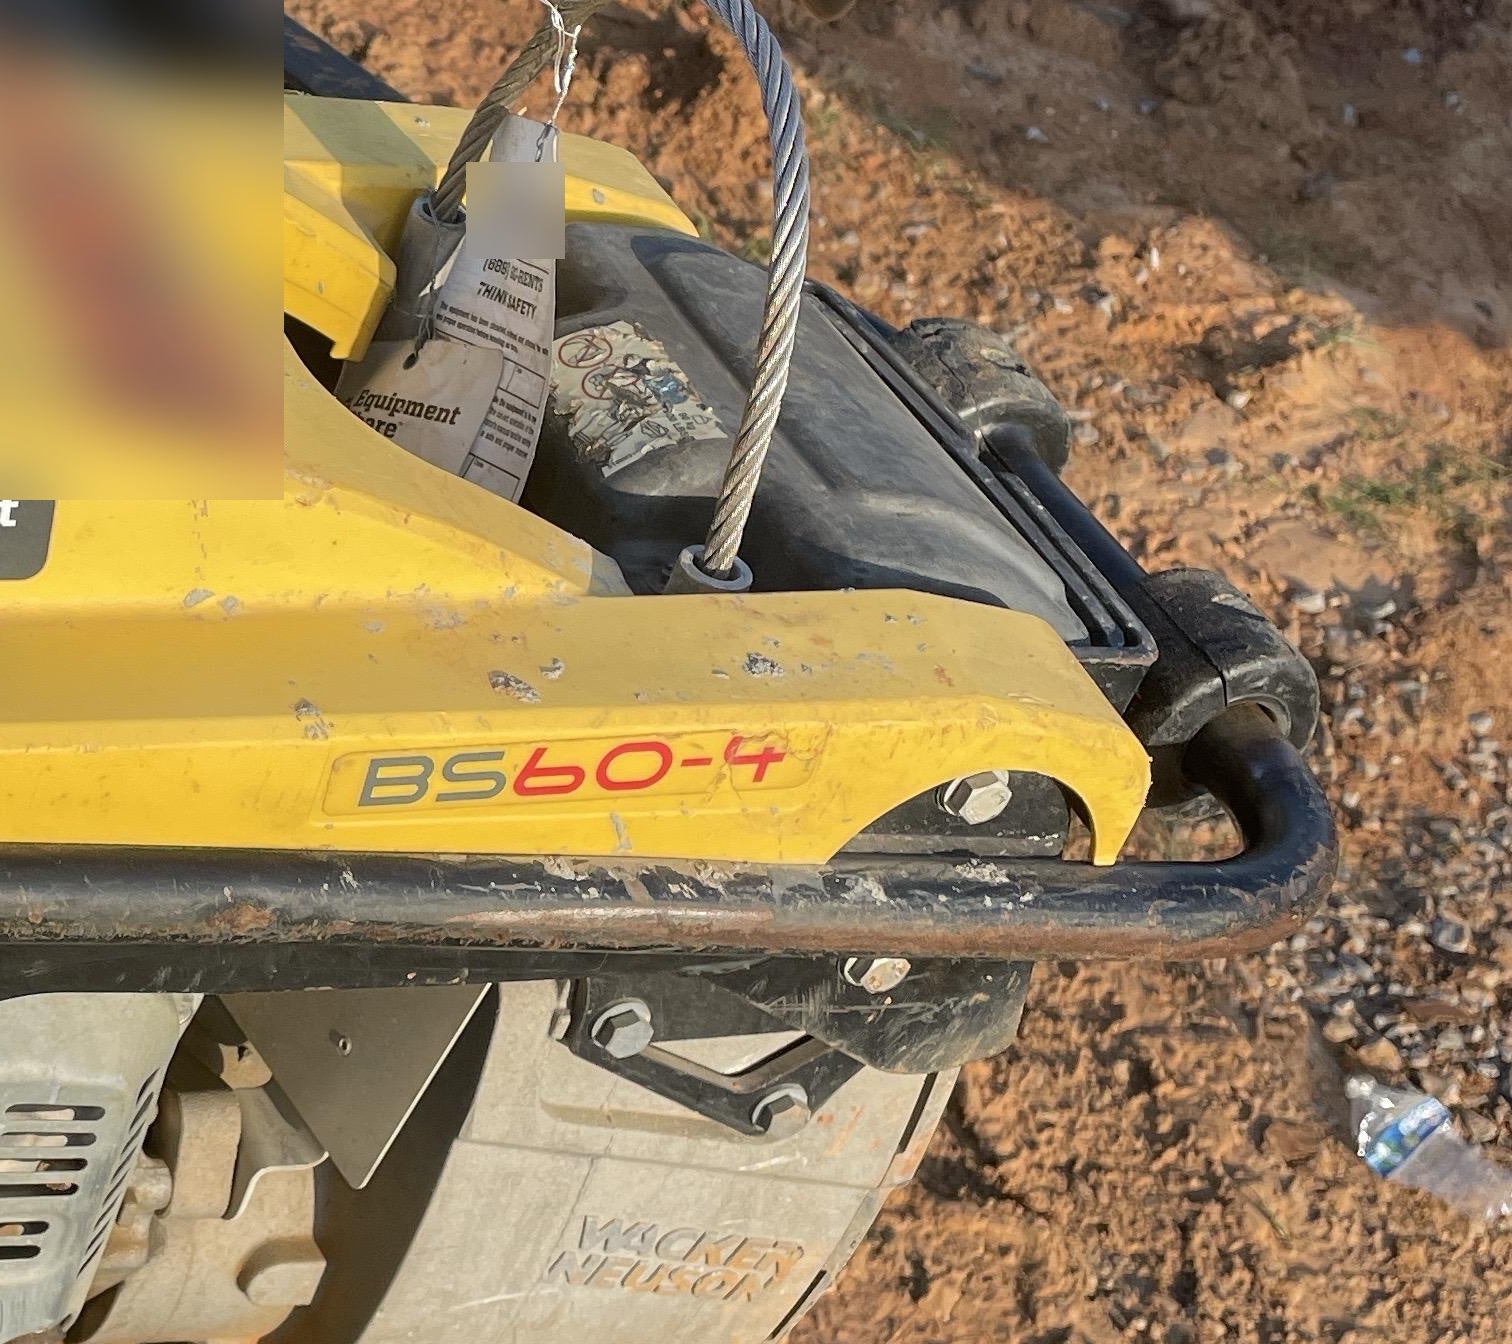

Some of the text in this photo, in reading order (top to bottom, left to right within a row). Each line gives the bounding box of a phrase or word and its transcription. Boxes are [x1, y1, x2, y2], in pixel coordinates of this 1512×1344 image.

[353, 388, 462, 426] Equipment
[357, 735, 787, 808] BS60-4
[577, 1213, 805, 1277] WACKER
[542, 1250, 779, 1302] NEUSON
